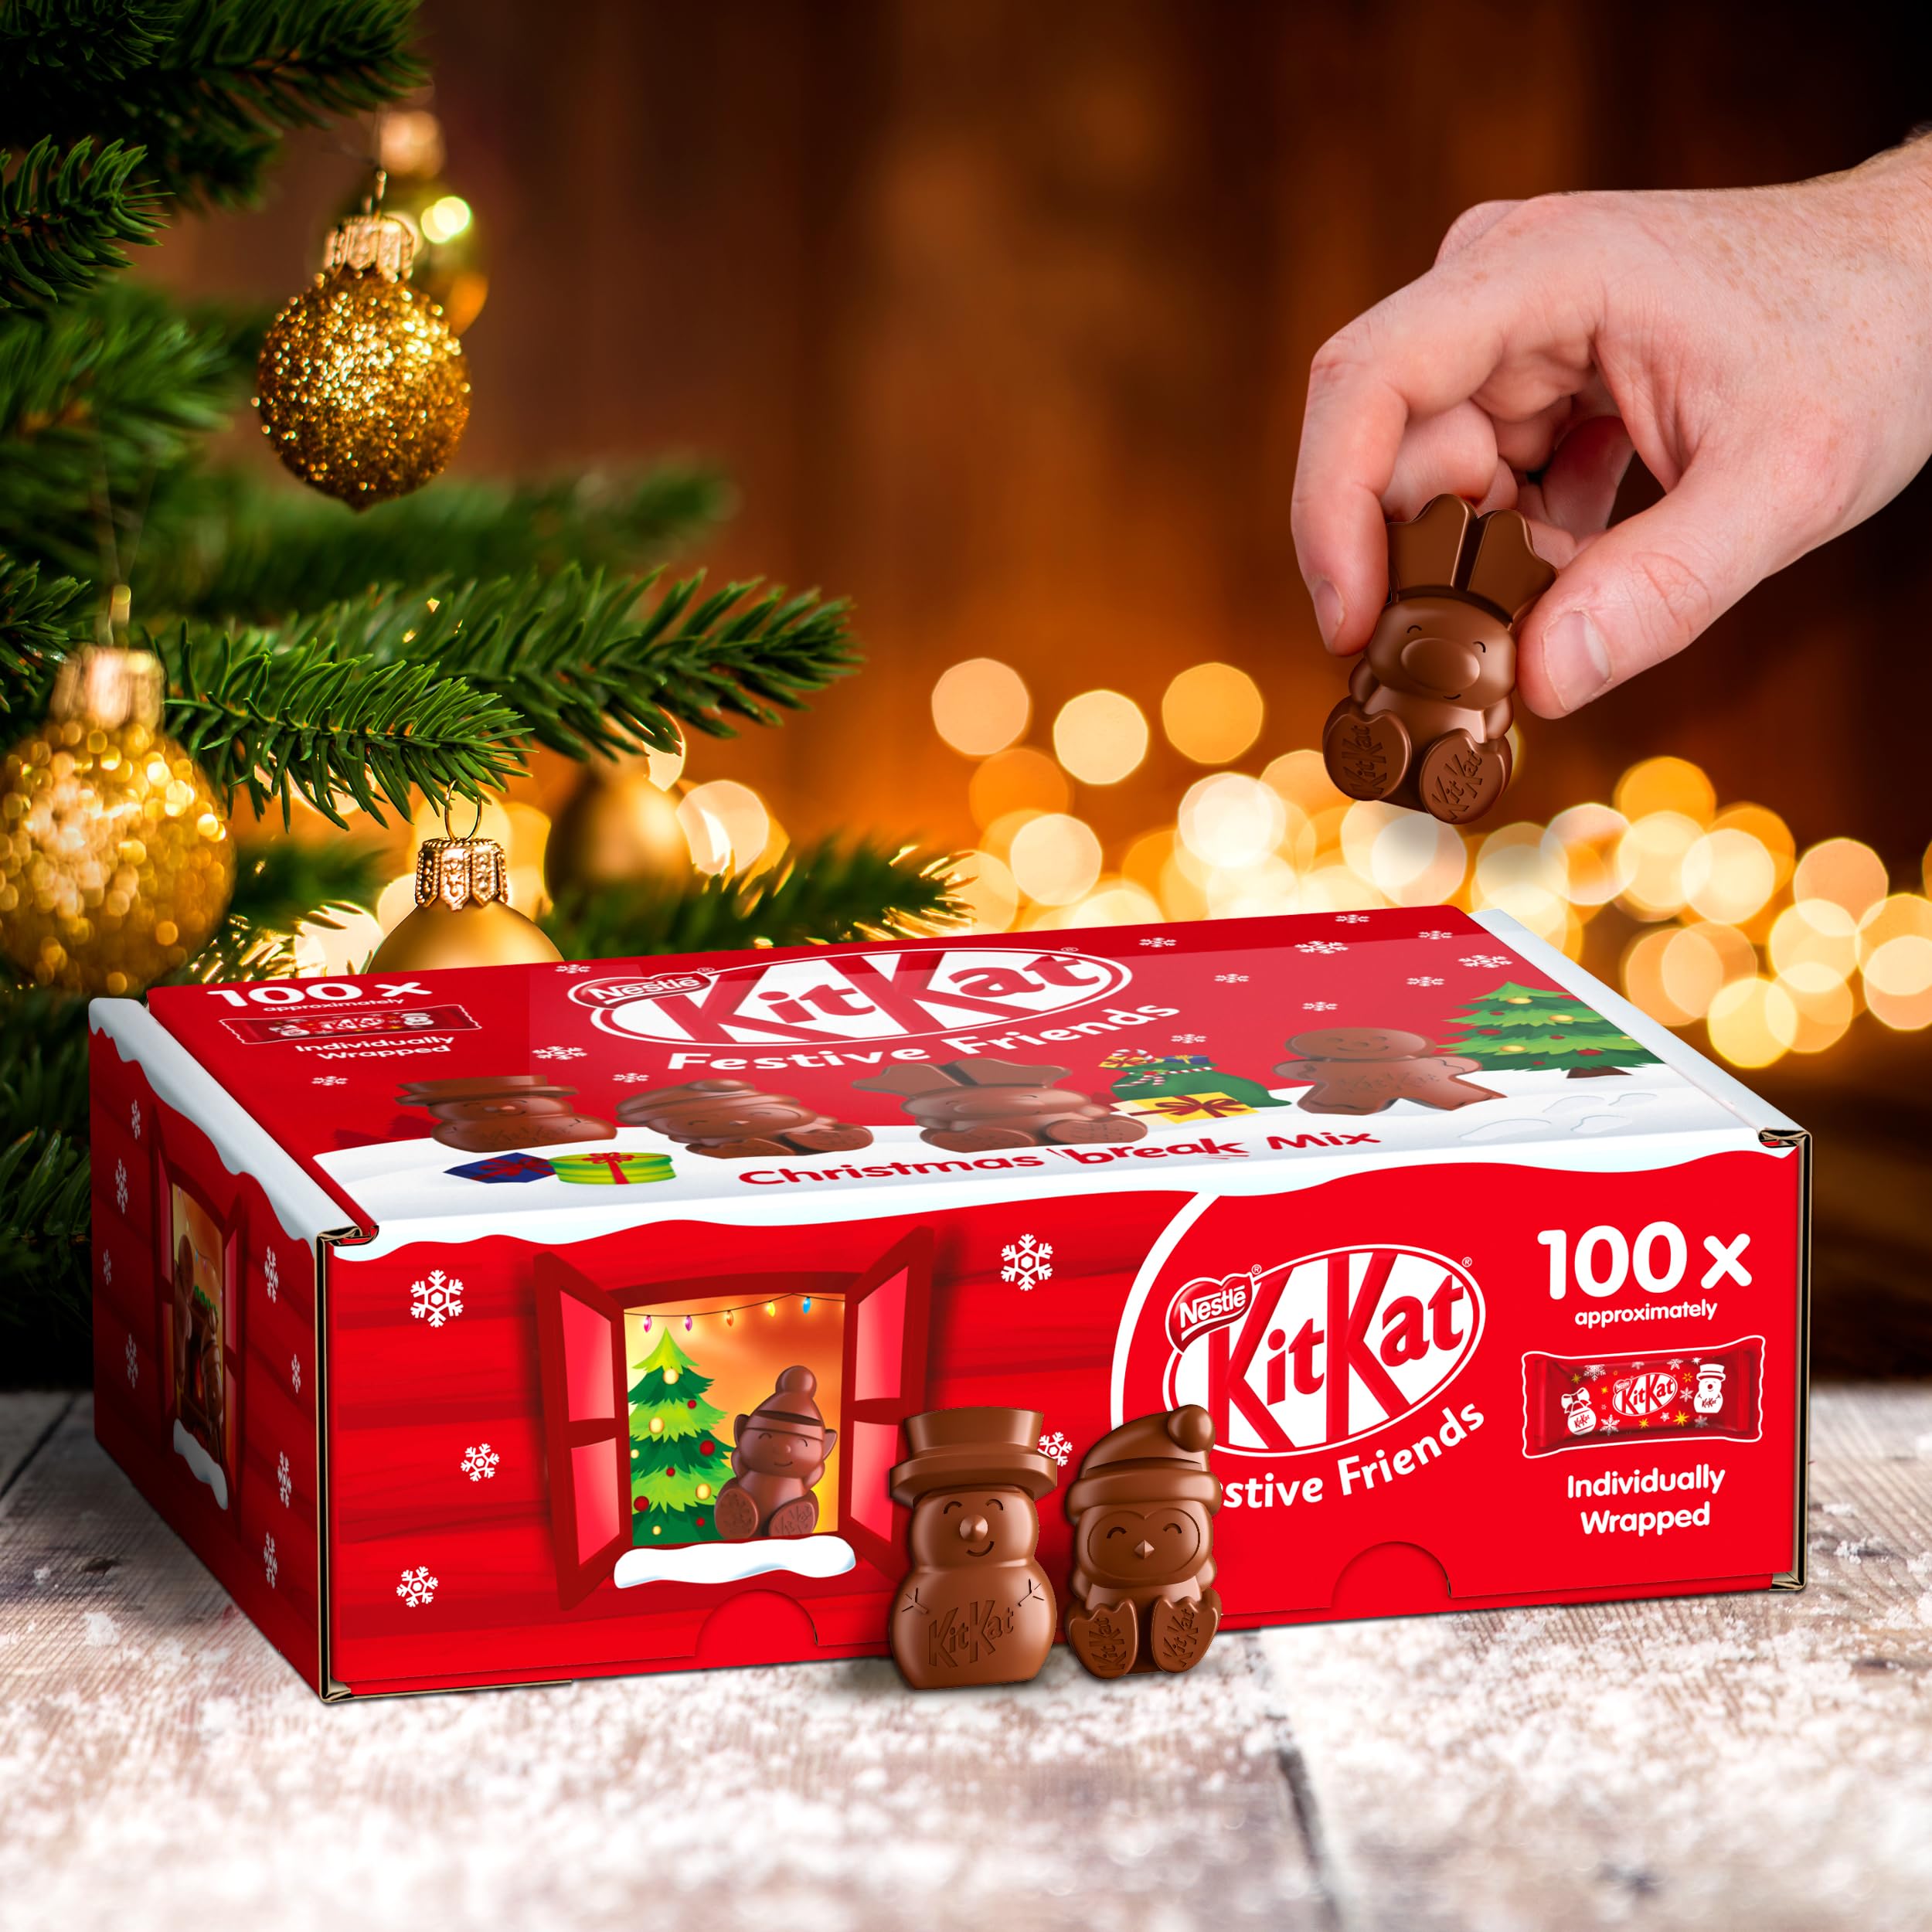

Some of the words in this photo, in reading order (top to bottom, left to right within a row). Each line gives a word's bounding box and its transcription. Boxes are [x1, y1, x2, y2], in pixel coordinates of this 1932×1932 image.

[1341, 724, 1387, 795] KitKat
[1431, 750, 1483, 821] KitKat
[206, 982, 363, 1007] 100
[374, 982, 433, 997] x
[263, 998, 405, 1012] approximately
[651, 951, 1100, 1044] KitKat
[294, 1036, 454, 1052] Individually
[317, 1045, 451, 1060] Wrapped
[668, 1047, 930, 1071] Festive
[940, 1003, 1181, 1055] Friends
[738, 1148, 1044, 1186] Christmas
[1266, 1132, 1382, 1150] Mix
[1537, 1220, 1688, 1300] 100
[1701, 1233, 1753, 1289] x
[1575, 1298, 1718, 1328] approximately
[1207, 1252, 1464, 1449] KitKat
[1573, 1413, 1590, 1428] KitKat
[1621, 1374, 1674, 1415] KitKat
[1220, 1472, 1323, 1509] stive
[1337, 1403, 1485, 1495] Friends
[1567, 1464, 1726, 1498] Individually
[1580, 1501, 1710, 1536] Wrapped
[927, 1599, 1014, 1668] KitKat
[1088, 1617, 1127, 1673] KitKat
[1162, 1607, 1199, 1669] KitKat
